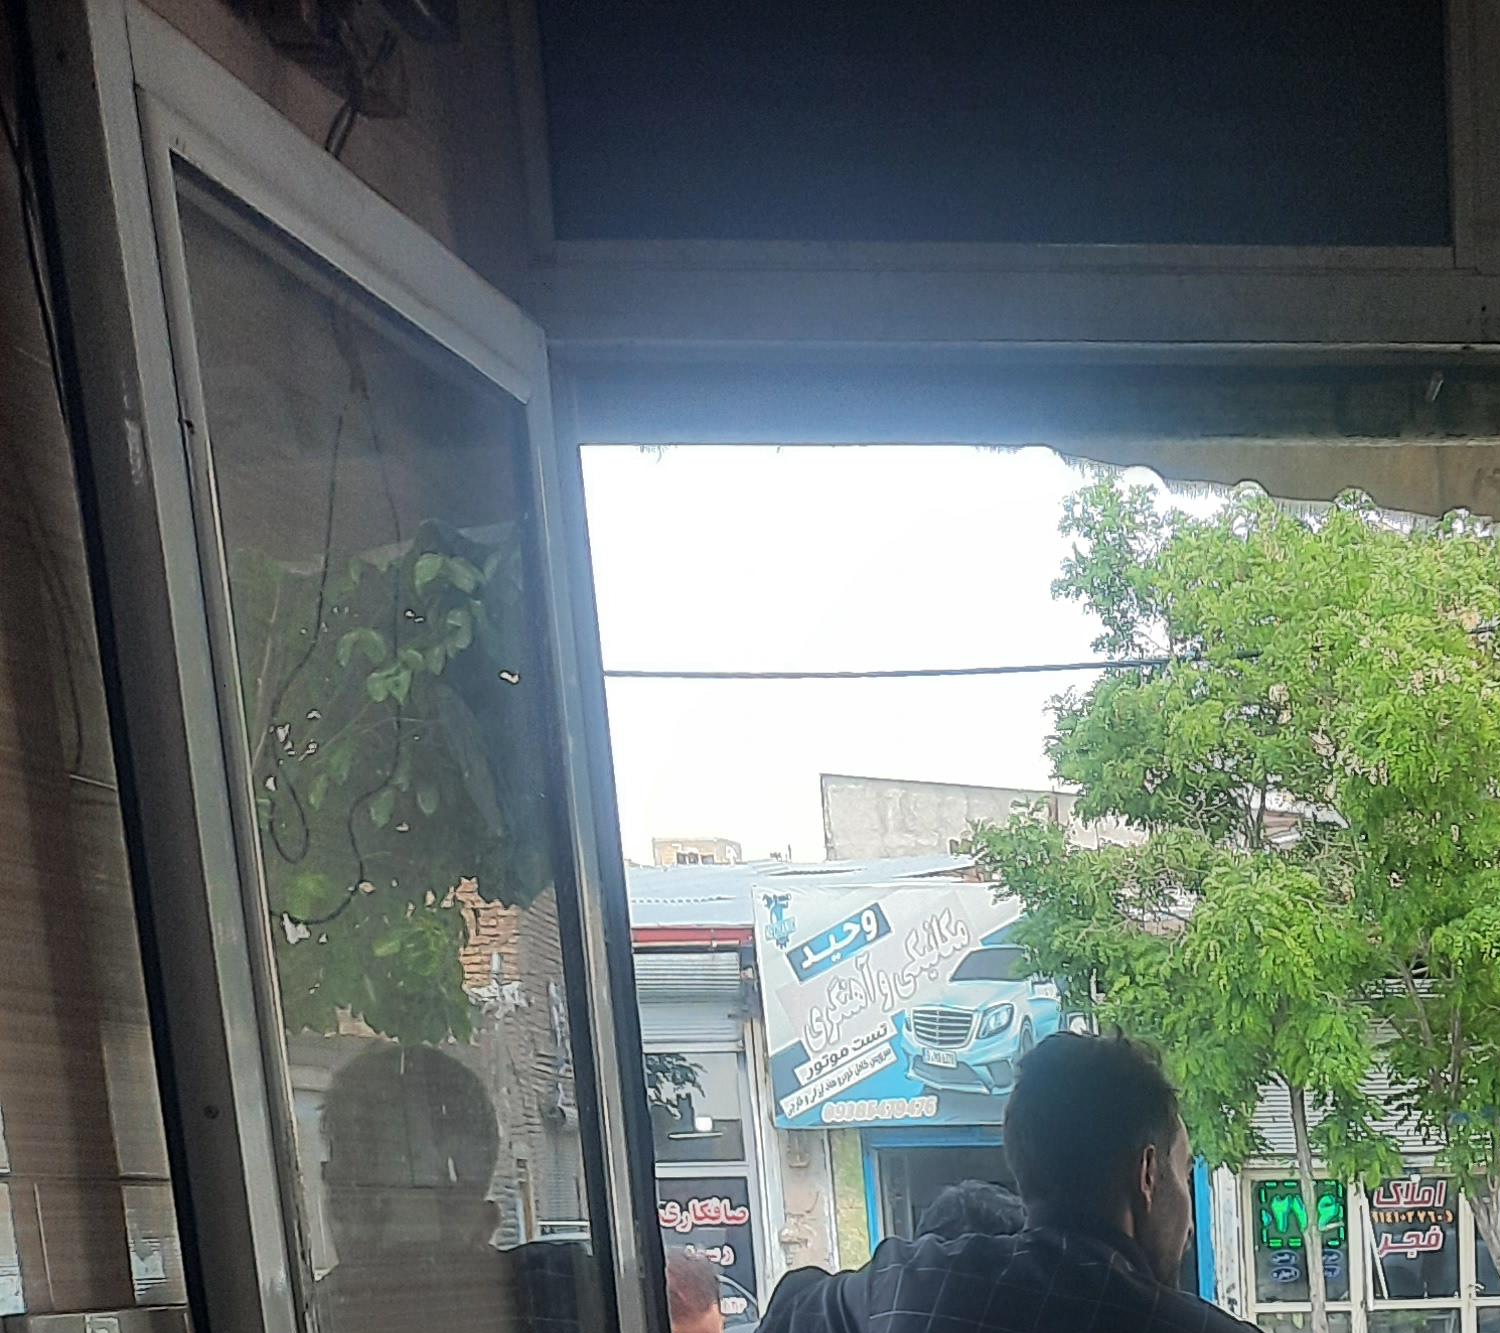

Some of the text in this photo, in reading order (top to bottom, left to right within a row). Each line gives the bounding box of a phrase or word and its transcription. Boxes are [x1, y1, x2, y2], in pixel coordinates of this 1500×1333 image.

[801, 908, 879, 969] وحید
[804, 908, 970, 1052] مکانیکی و آهنگری
[806, 1023, 888, 1080] تست موتور
[658, 1197, 750, 1233] صافکاری
[1373, 1179, 1447, 1208] املاک
[1379, 1225, 1444, 1259] فجر
